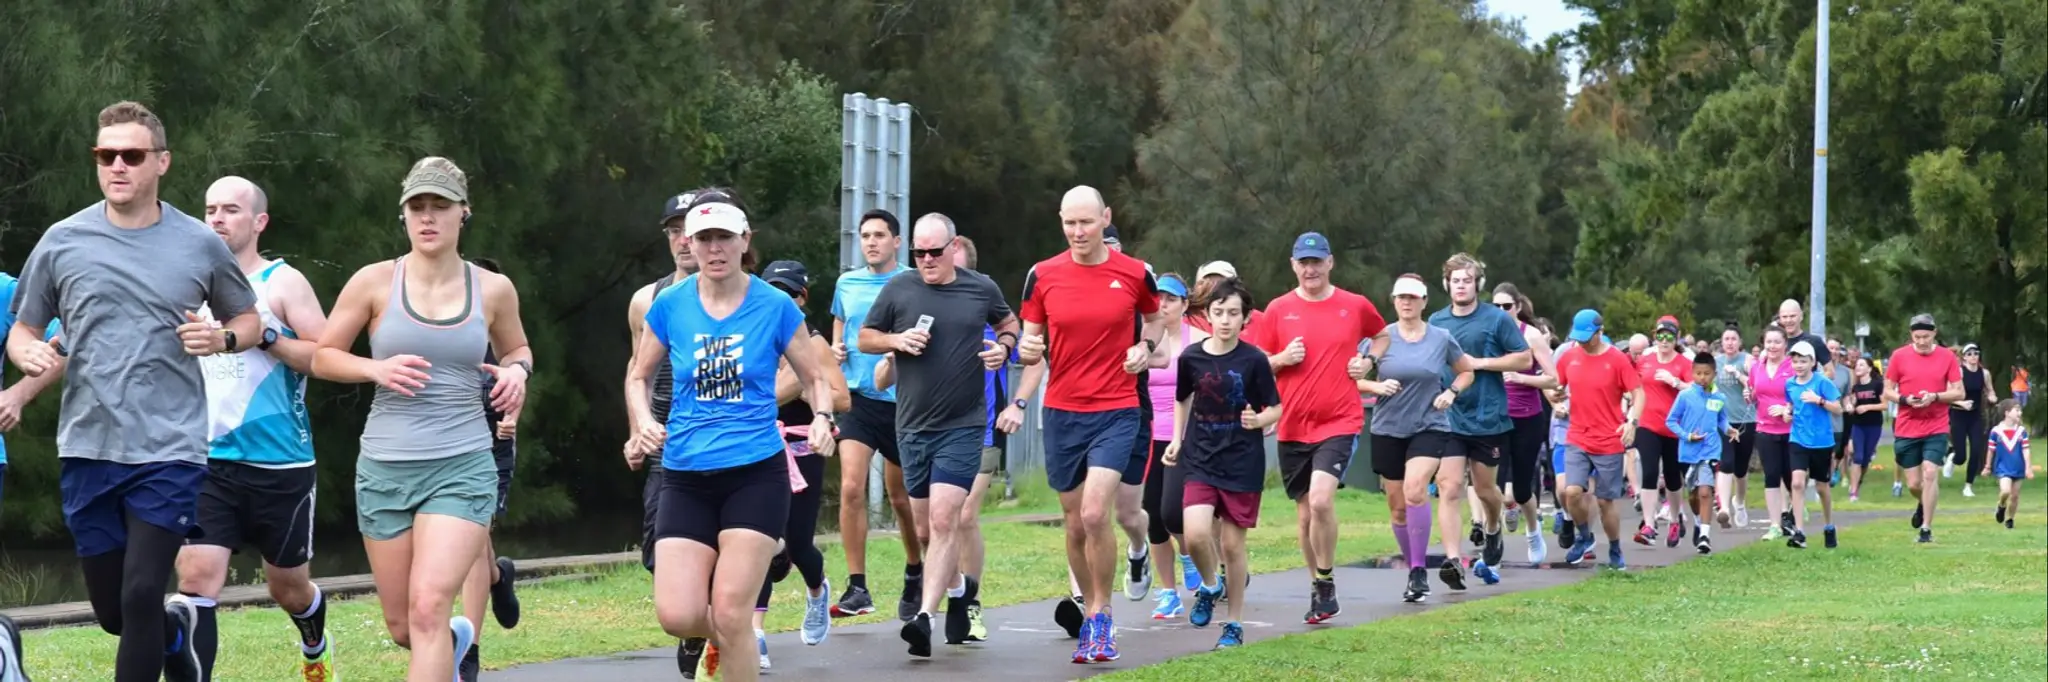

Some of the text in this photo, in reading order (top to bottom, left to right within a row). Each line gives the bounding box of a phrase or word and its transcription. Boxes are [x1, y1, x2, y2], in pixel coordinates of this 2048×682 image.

[702, 336, 733, 358] WE
[698, 359, 737, 380] RUN
[696, 380, 742, 400] MUM
